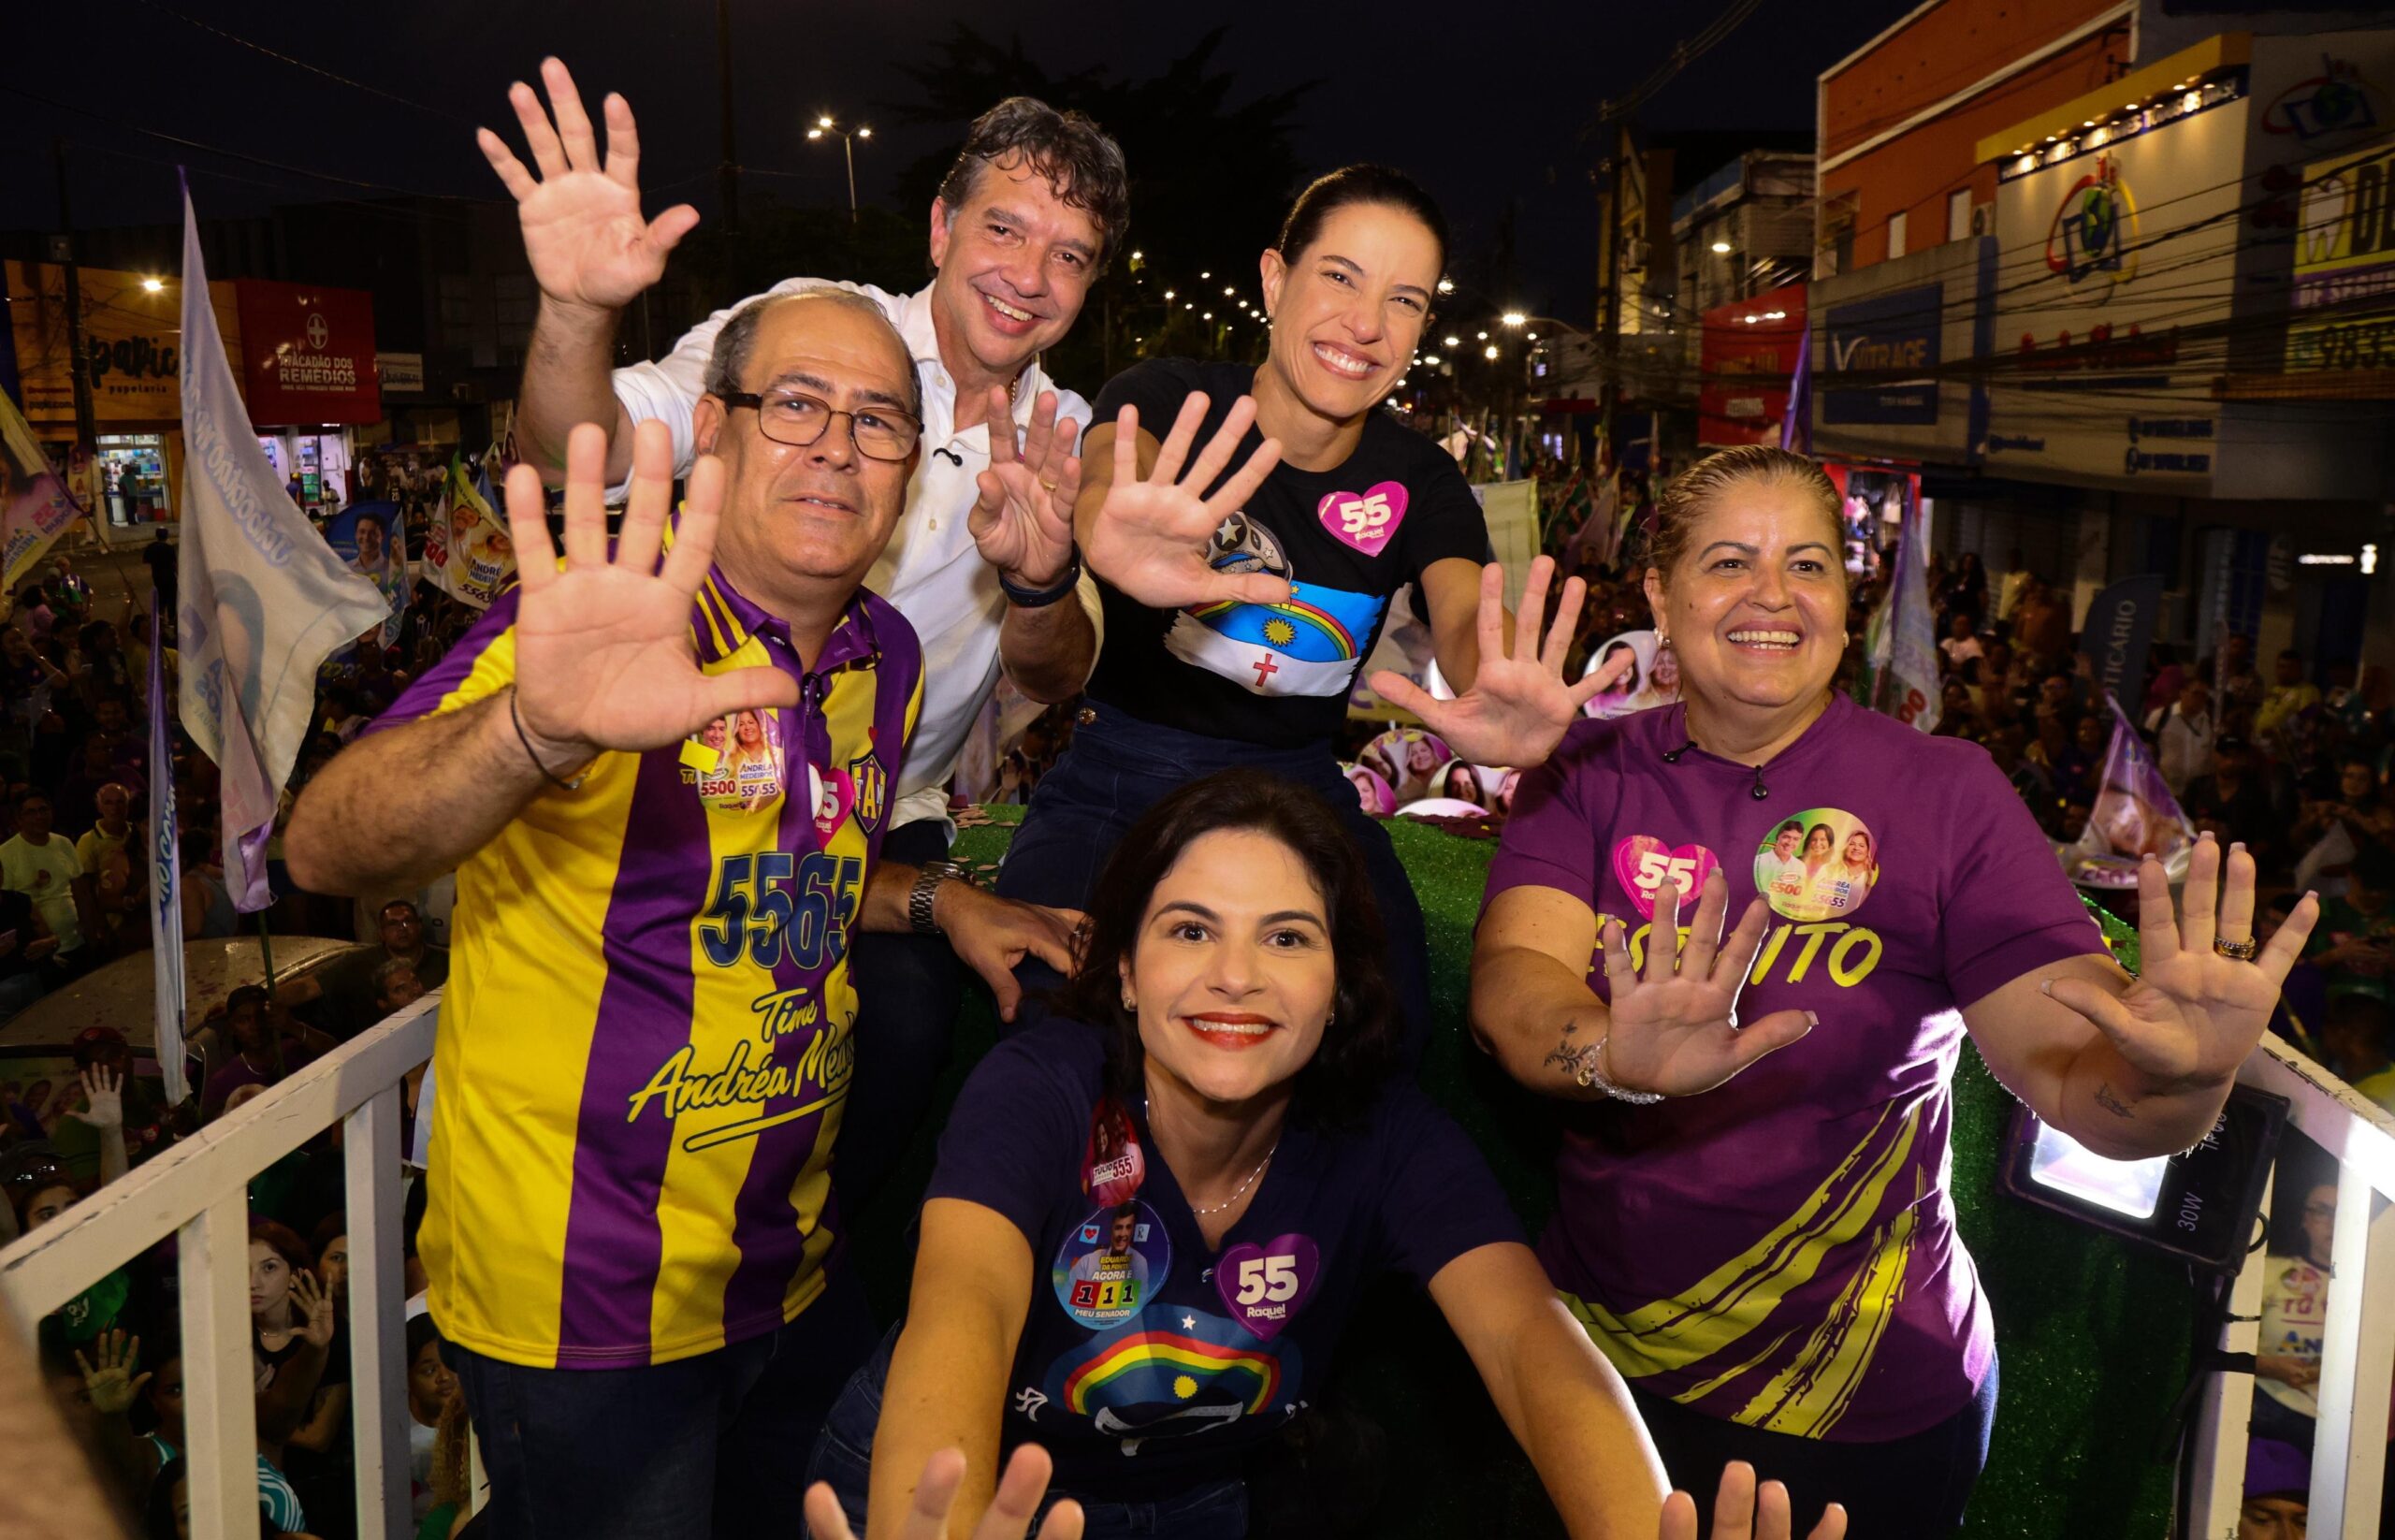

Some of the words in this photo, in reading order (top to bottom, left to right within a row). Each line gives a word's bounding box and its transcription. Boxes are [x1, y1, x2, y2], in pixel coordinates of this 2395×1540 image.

[333, 356, 354, 370] DOS
[279, 368, 356, 385] REMÉDIOS
[1339, 492, 1392, 534] 55
[701, 780, 736, 796] 5500
[1633, 851, 1697, 894] 55
[753, 988, 819, 1044] Time
[627, 1040, 791, 1124] Andréa
[1112, 1156, 1134, 1179] 555
[2178, 1192, 2204, 1232] 30W
[1092, 1271, 1125, 1280] AGORA
[1235, 1255, 1299, 1305] 55
[1074, 1308, 1096, 1317] MEU
[1095, 1310, 1131, 1318] SENADOR
[1247, 1304, 1286, 1319] Raquel
